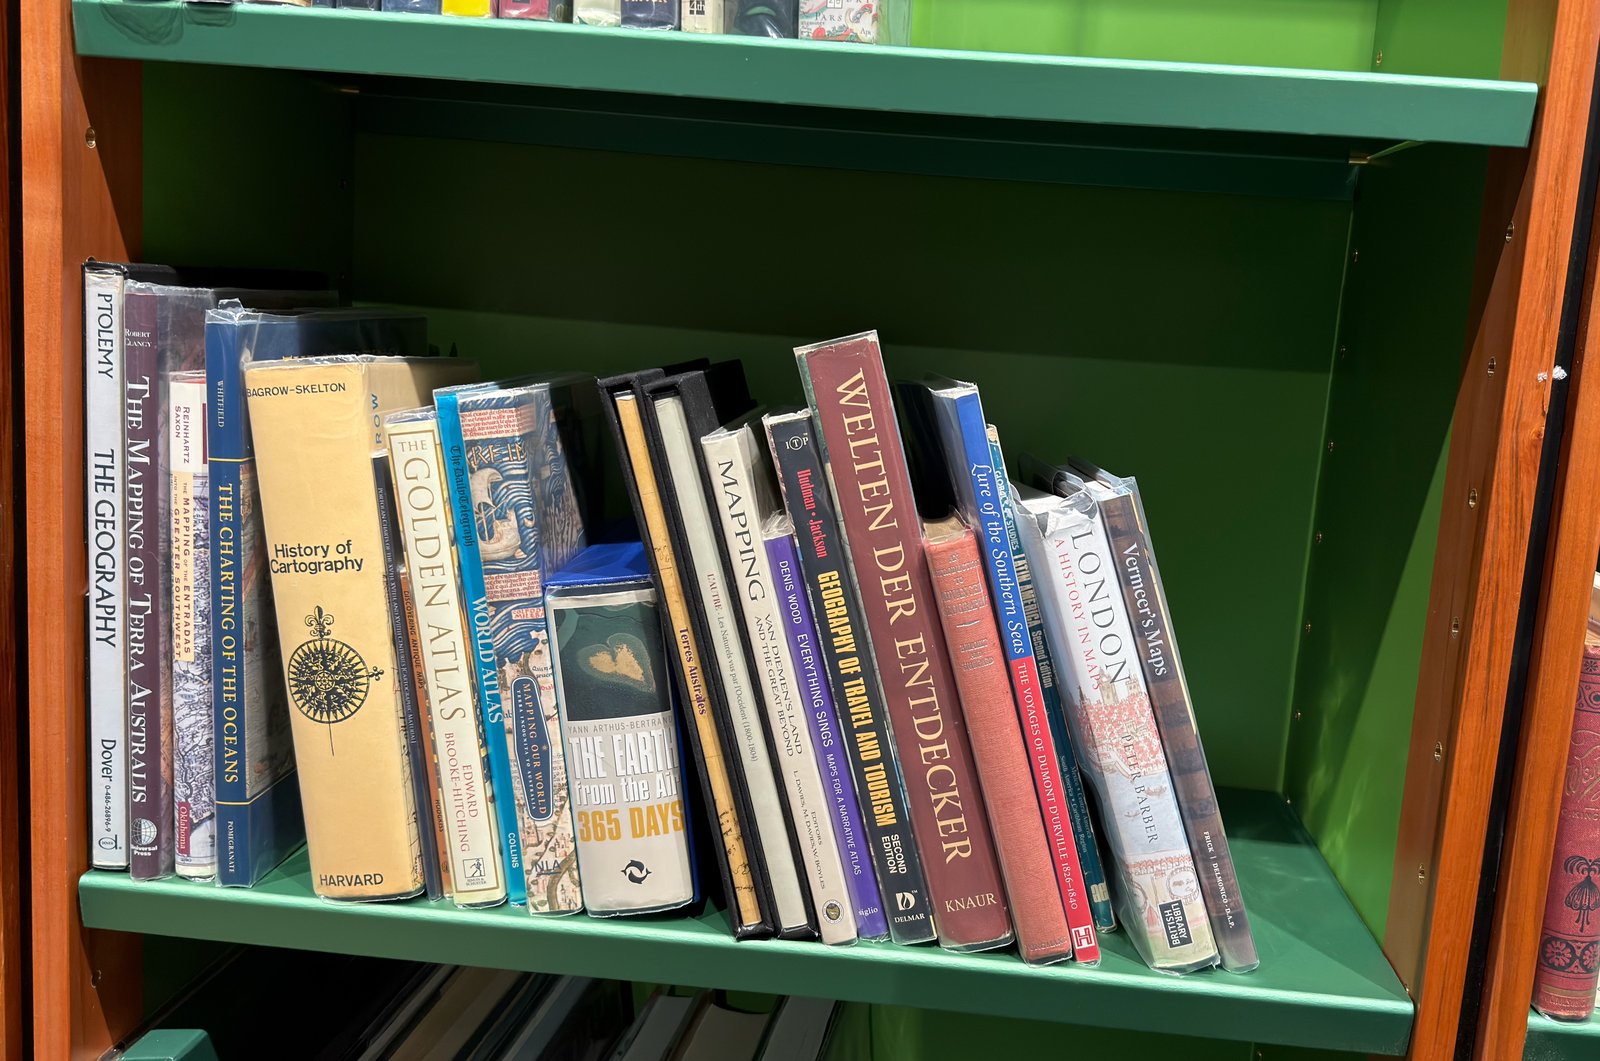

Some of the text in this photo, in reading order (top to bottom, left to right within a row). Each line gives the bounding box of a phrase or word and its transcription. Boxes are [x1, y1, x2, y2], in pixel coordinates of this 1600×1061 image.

[815, 12, 843, 21] PARS
[97, 293, 113, 379] PTOLEMY
[124, 328, 152, 338] ROBERT
[246, 382, 346, 398] BAGROW-SKELTON
[182, 406, 190, 464] REINHARTZ
[398, 440, 428, 452] THE
[836, 367, 898, 532] WELTEN
[378, 488, 387, 518] PORTOLAN
[450, 446, 464, 466] The
[458, 495, 472, 548] Telegraph
[796, 468, 828, 558] Hudman Jackson
[94, 449, 116, 648] THE GEOGRAPHY
[173, 508, 181, 570] GREATER
[182, 497, 190, 556] MAPPING
[274, 540, 352, 558] History of
[718, 459, 766, 601] MAPPING
[1006, 520, 1020, 551] STUDIES
[270, 556, 364, 575] Cartography
[873, 540, 917, 626] DER
[972, 462, 1025, 655] Lure of the Southern Seas
[126, 376, 152, 803] THE MAPPING OF TERRA AUSTRALIS
[403, 456, 466, 722] GOLDEN ATLAS
[1054, 538, 1102, 690] A HISTORY IN MAPS
[1072, 528, 1130, 684] LONDON
[1123, 542, 1167, 676] Vermeer's Maps
[218, 483, 238, 784] THE CHARTING OF THE OCEANS
[404, 590, 414, 636] DISCOVERING
[412, 638, 420, 669] ANTIQUE
[1013, 553, 1052, 688] LATIN AMERICA Second Edition
[472, 596, 503, 724] WORLD ATLAS
[680, 626, 707, 716] Terres Australes
[706, 573, 722, 610] L'AUTRE
[717, 616, 725, 628] Les
[721, 630, 734, 658] Naturels
[730, 672, 739, 685] par
[742, 722, 758, 762] (1800-1804)
[754, 616, 794, 757] AND THE GREAT BEYOND
[764, 614, 802, 755] VAN DIEMEN'S LAND
[1018, 662, 1029, 686] THE
[568, 714, 673, 735] YANN ARTHUS-BERTRAND
[779, 560, 794, 592] DENIS
[788, 594, 802, 624] WOOD
[798, 634, 824, 708] EVERYTHING
[816, 711, 834, 748] SINGS
[826, 753, 838, 777] MAPS
[832, 778, 842, 795] FOR
[838, 804, 856, 848] NARRATIVE
[850, 850, 862, 876] ATLAS
[817, 570, 897, 826] GEOGRAPHY OF TRAVEL AND TOURISM
[1022, 688, 1042, 736] VOYAGES
[100, 739, 116, 782] Dover
[520, 716, 528, 755] INCOGNITA
[526, 758, 530, 768] TO
[528, 770, 536, 810] AUSTRALIA
[522, 683, 546, 814] MAPPING OUR WORLD
[568, 727, 680, 779] THE EARTH
[894, 636, 972, 865] ENTDECKER
[1033, 736, 1044, 752] OF
[444, 732, 471, 852] BROOKE-HITCHING
[462, 764, 478, 818] EDWARD
[574, 772, 680, 806] from the Air
[1038, 754, 1056, 804] DUMONT
[1122, 734, 1158, 844] PETER BARBER
[179, 806, 187, 850] Oklahoma
[576, 800, 684, 842] 365 DAYS
[811, 811, 822, 846] EDITORS
[1049, 805, 1068, 860] D'URVILLE
[508, 832, 519, 868] COLLINS
[534, 860, 562, 873] NLA
[815, 860, 826, 890] BOYLES
[882, 836, 898, 874] EDITION
[890, 833, 908, 875] SECOND
[320, 873, 384, 887] HARVARD
[945, 892, 998, 913] KNAUR
[1204, 831, 1234, 928] FRICK DELMONICO D.A.P.
[858, 906, 878, 917] siglio
[894, 912, 925, 924] DELMAR
[1164, 909, 1180, 945] BRITISH
[1171, 902, 1188, 940] LIBRARY
